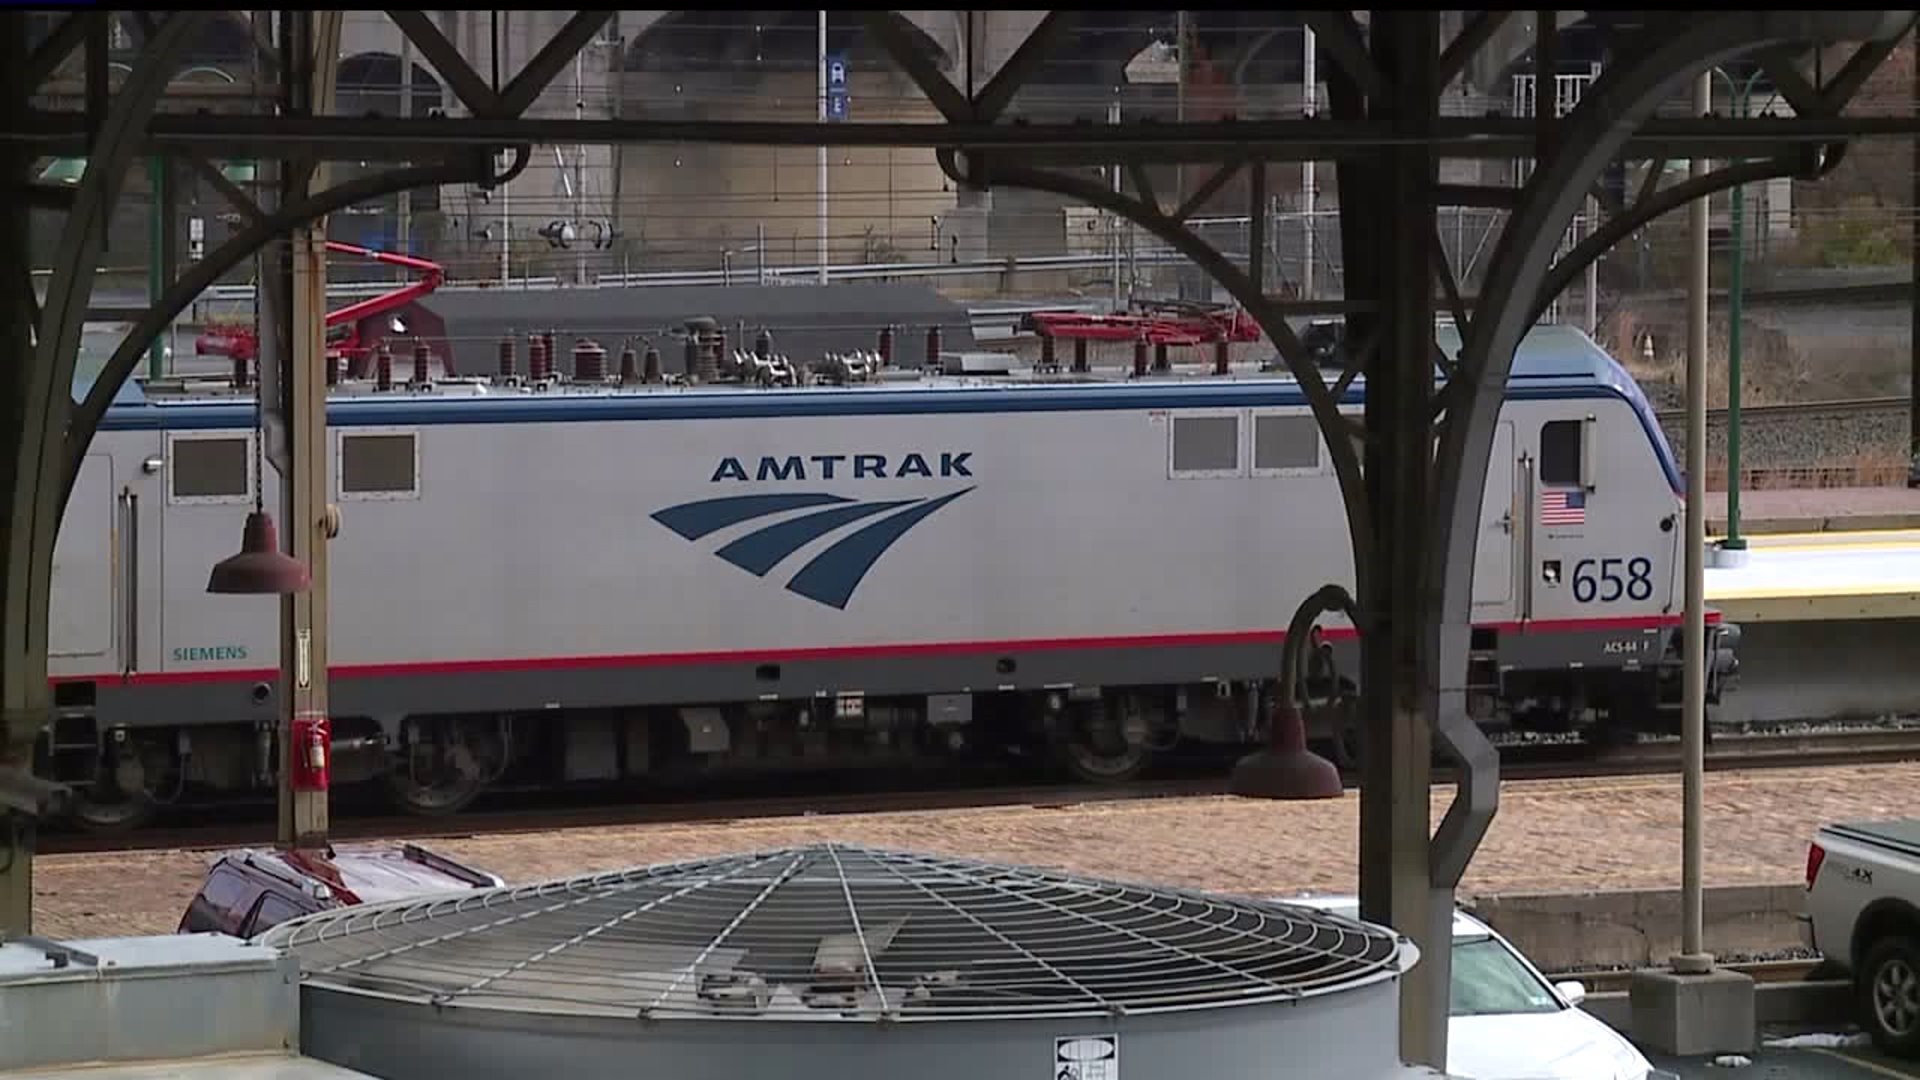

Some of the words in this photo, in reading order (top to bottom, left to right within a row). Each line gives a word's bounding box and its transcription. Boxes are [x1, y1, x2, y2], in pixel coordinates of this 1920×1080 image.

[709, 452, 973, 482] AMTRAK
[1572, 557, 1653, 603] 658
[173, 646, 248, 661] SIEMENS
